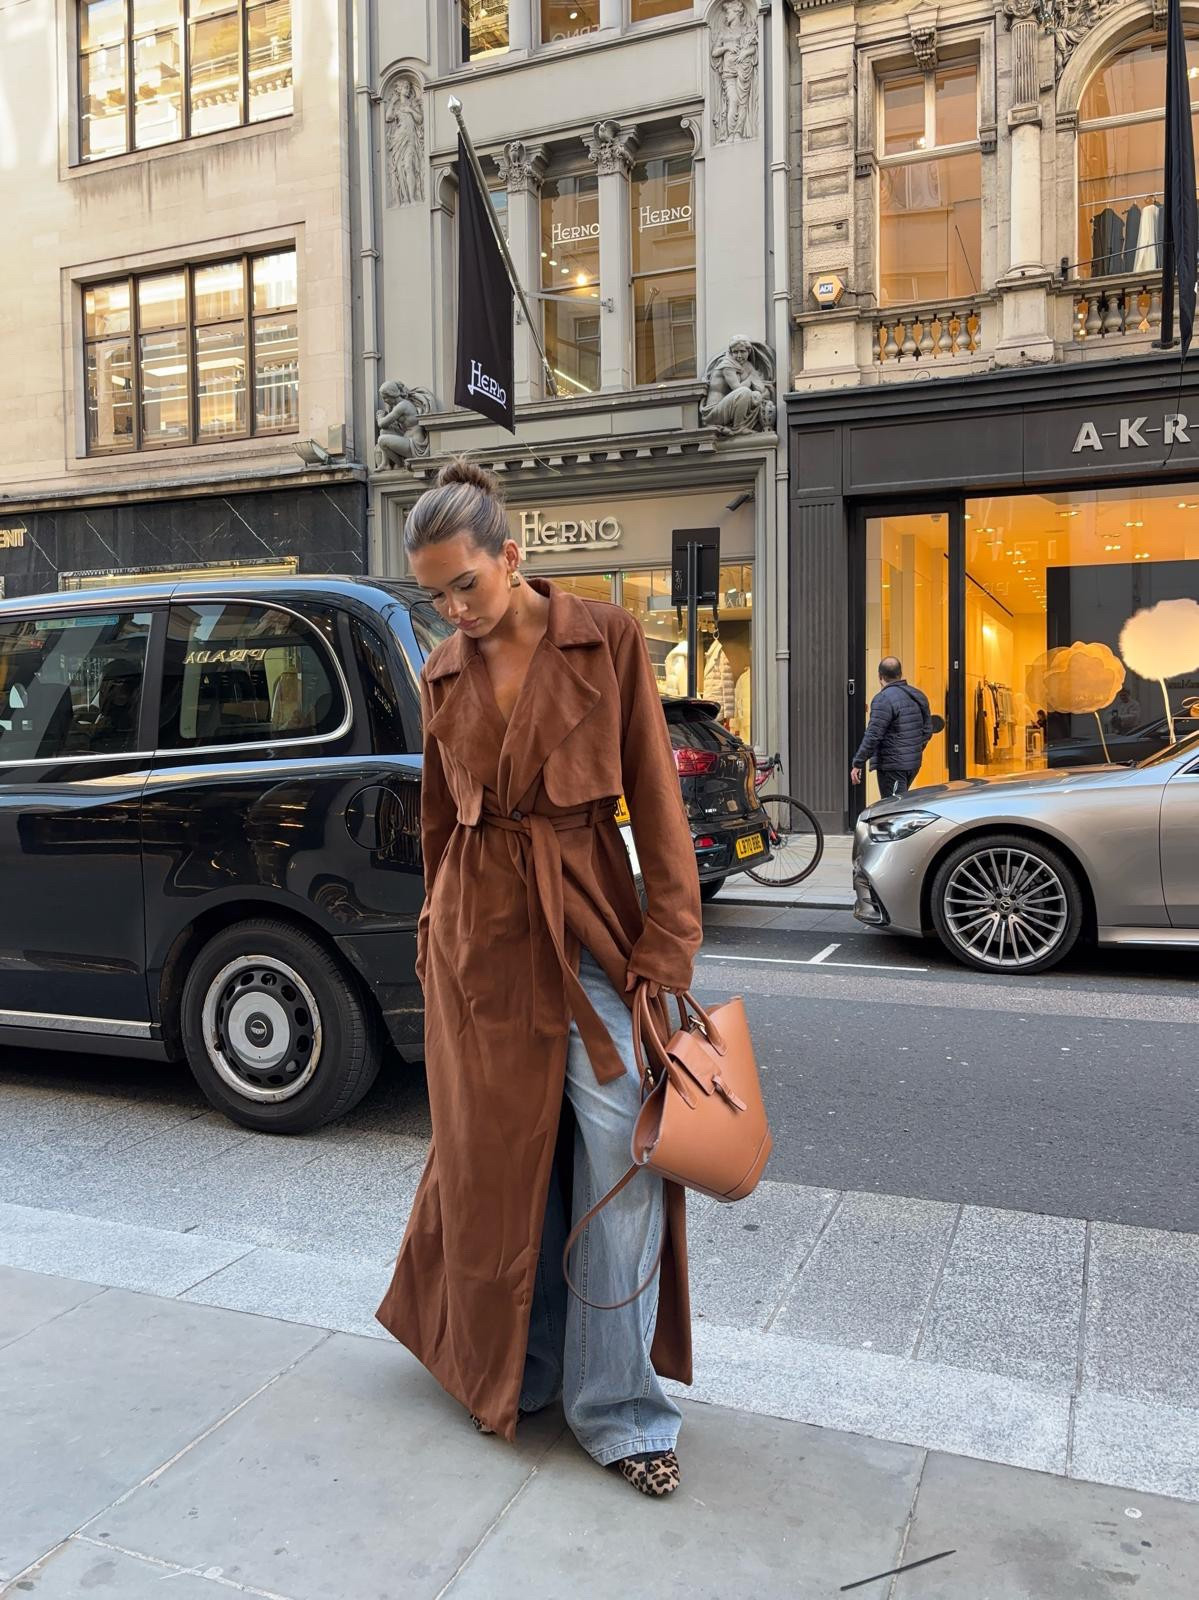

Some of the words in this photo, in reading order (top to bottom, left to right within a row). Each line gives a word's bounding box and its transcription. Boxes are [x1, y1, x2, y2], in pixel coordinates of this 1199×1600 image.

[639, 205, 692, 233] HERNO
[551, 222, 600, 249] HERNO
[519, 510, 621, 560] HERNO
